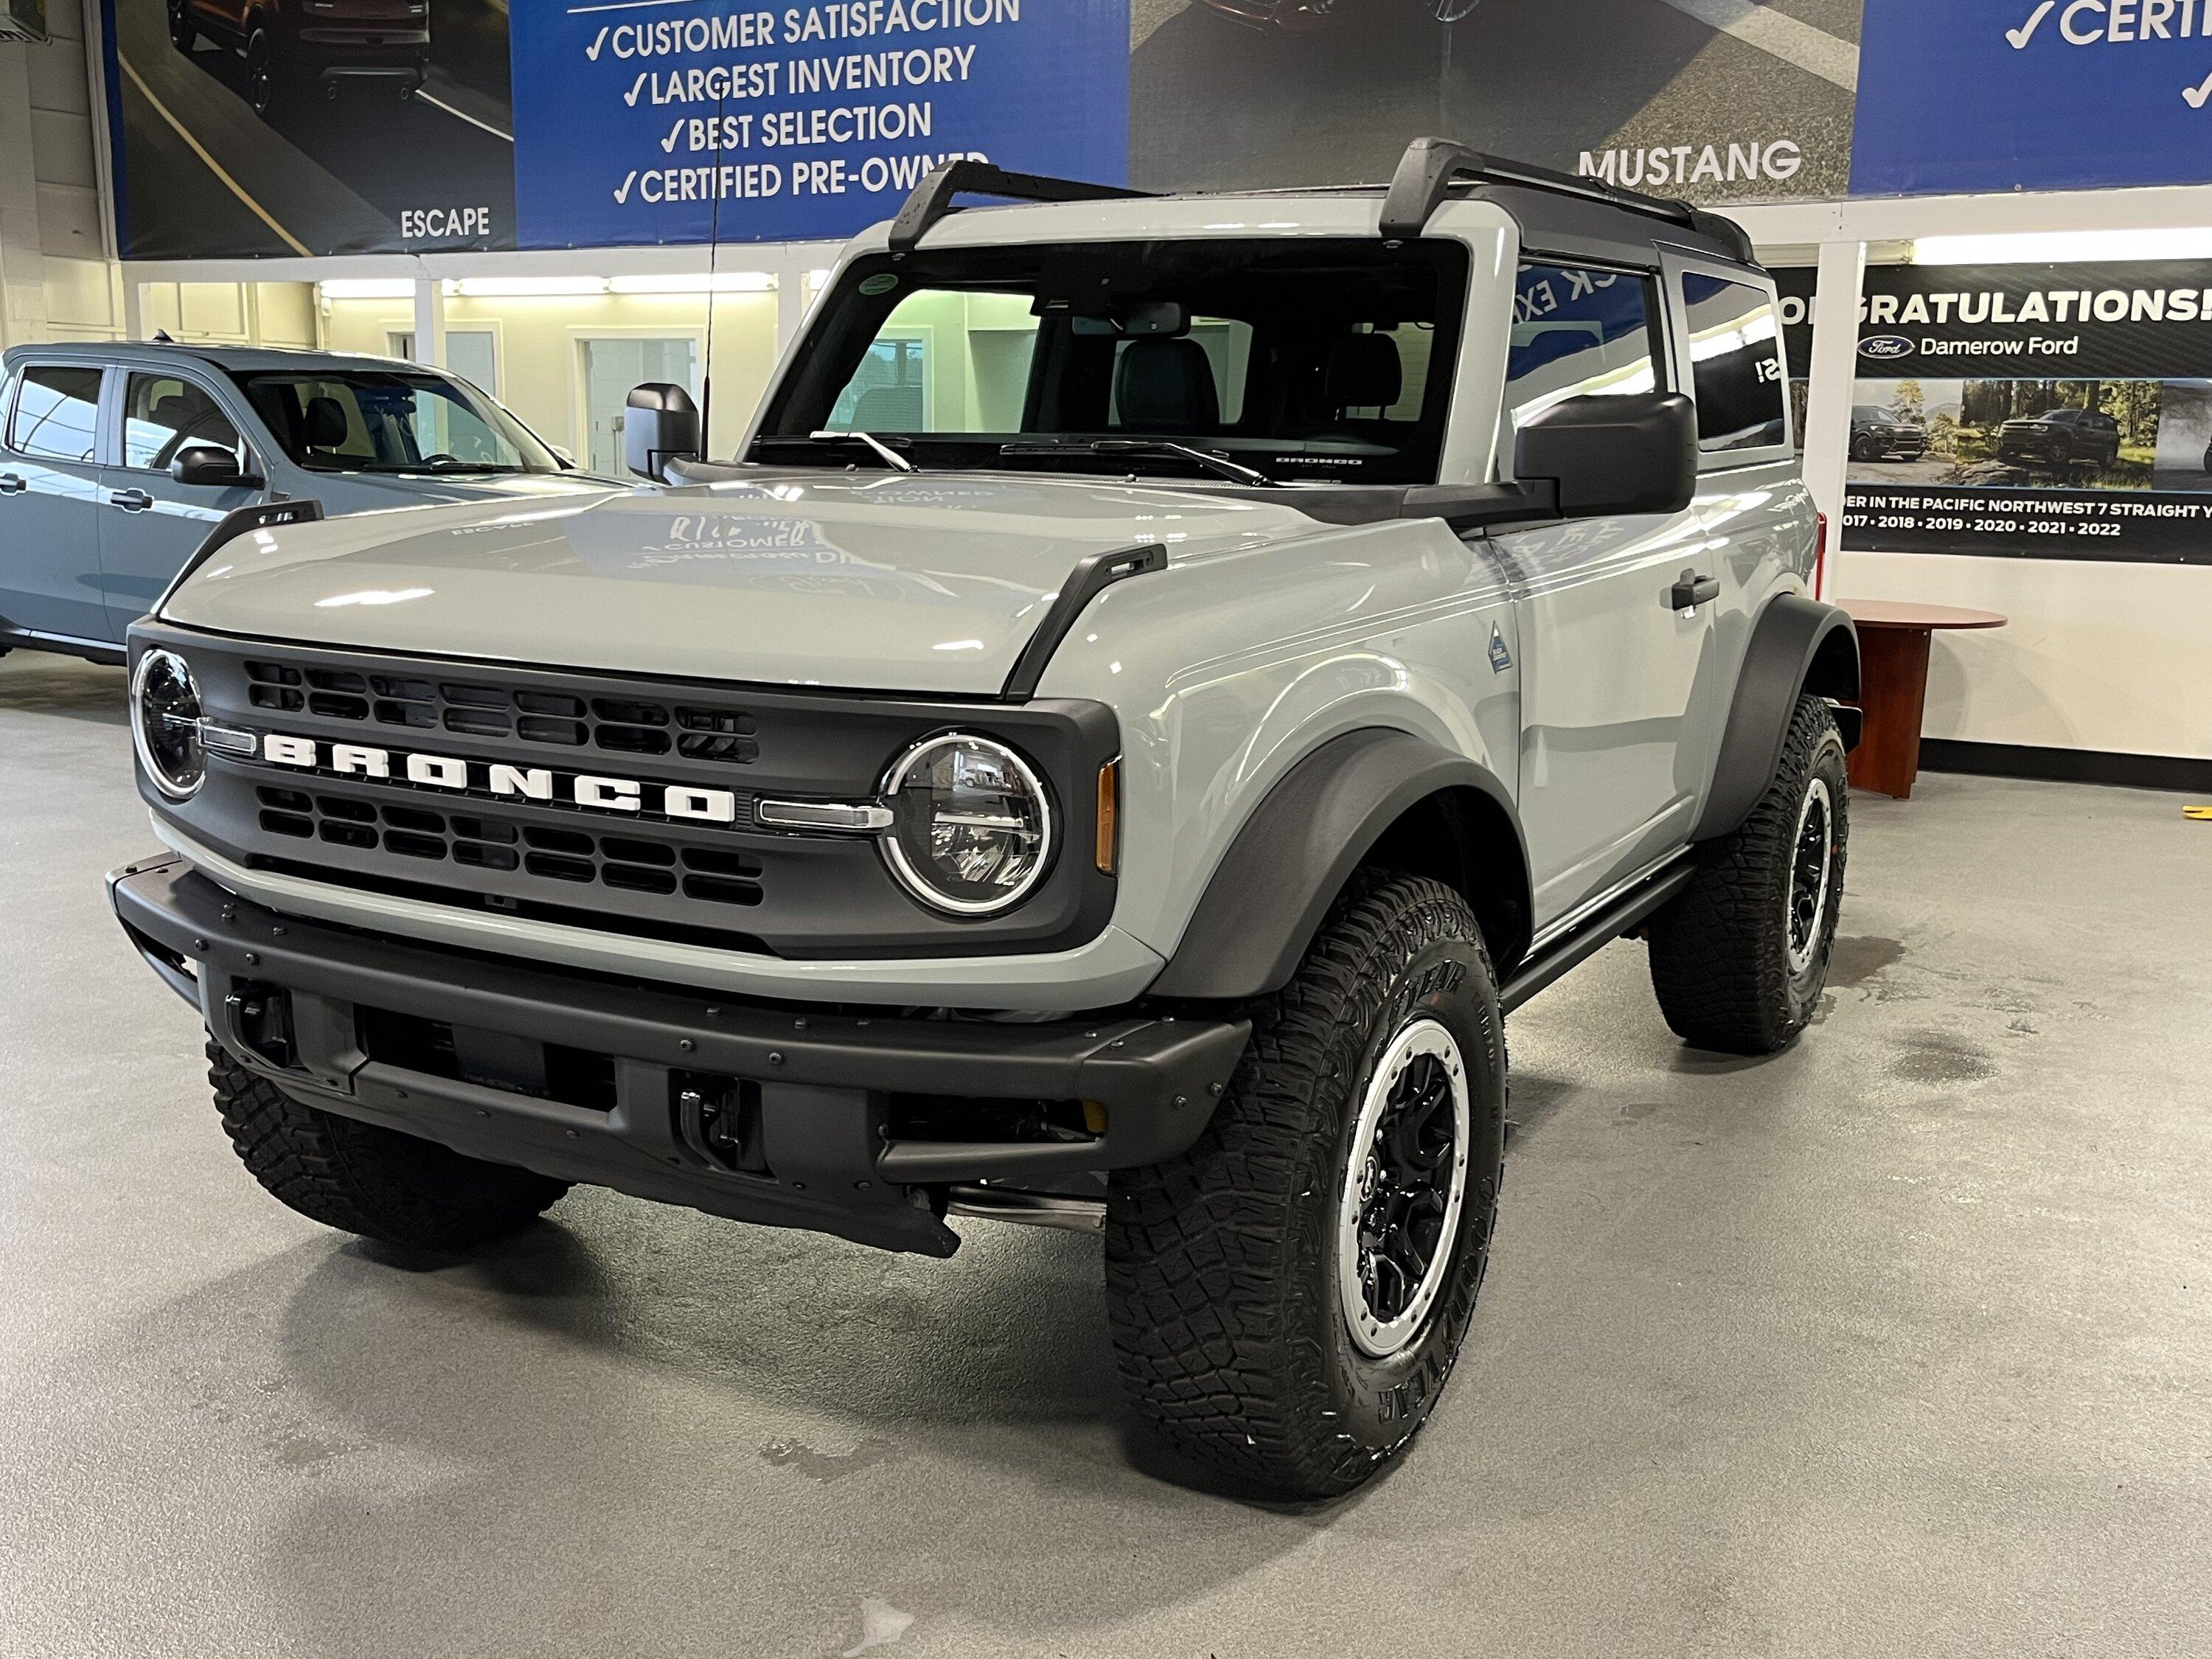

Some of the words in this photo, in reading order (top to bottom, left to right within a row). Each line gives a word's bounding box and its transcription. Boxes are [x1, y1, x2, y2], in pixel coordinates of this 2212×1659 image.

[612, 12, 775, 59] CUSTOMER
[784, 0, 1020, 44] SATISFACTION
[652, 62, 779, 105] LARGEST
[788, 44, 976, 94] INVENTORY
[689, 114, 753, 152] BEST
[762, 102, 931, 147] SELECTION
[640, 164, 782, 203] CERTIFIED
[1579, 140, 1802, 187] MUSTANG
[401, 207, 490, 238] ESCAPE
[1920, 338, 2024, 355] Damerow
[2028, 335, 2079, 355] Ford
[1843, 495, 1866, 507] ER
[1869, 496, 1886, 509] IN
[1888, 497, 1920, 509] THE
[1922, 498, 1985, 511] PACIFIC
[1988, 499, 2096, 515] NORTHWEST
[2098, 503, 2108, 515] 7
[2110, 503, 2199, 518] STRAIGHT
[1843, 515, 1868, 526] 017
[1877, 516, 1915, 529] 2018
[1925, 518, 1964, 530] 2019
[1973, 519, 2017, 532] 2020
[2027, 521, 2066, 534] 2021
[2077, 522, 2121, 536] 2022
[264, 733, 736, 822] BRONCO
